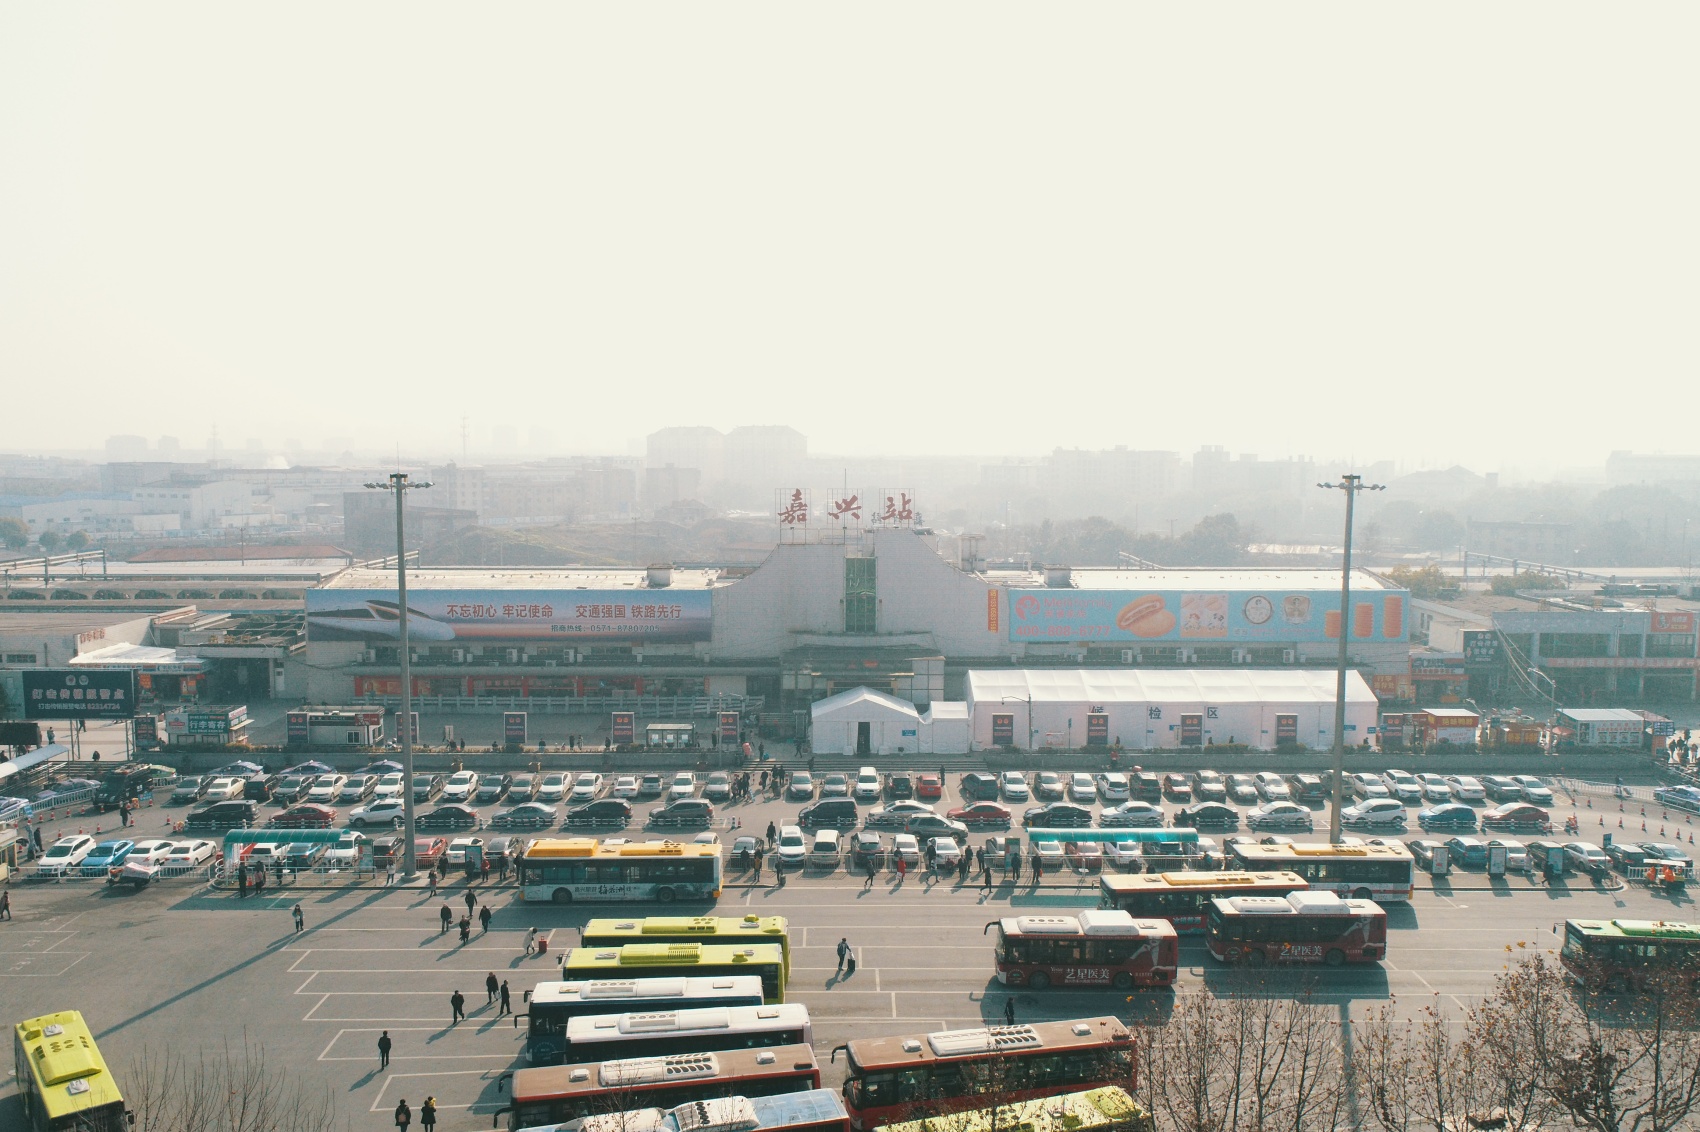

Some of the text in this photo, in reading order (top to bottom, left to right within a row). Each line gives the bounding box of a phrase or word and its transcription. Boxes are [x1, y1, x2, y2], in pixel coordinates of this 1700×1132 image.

[778, 488, 914, 524] 嘉兴站
[446, 603, 682, 619] 不忘初心 牢记使命 交通强国 铁路先行
[1015, 625, 1111, 637] 400-808-6777
[32, 688, 125, 700] 打击传销报警点
[189, 720, 226, 730] 行李寄存
[1065, 968, 1110, 979] 艺星医美
